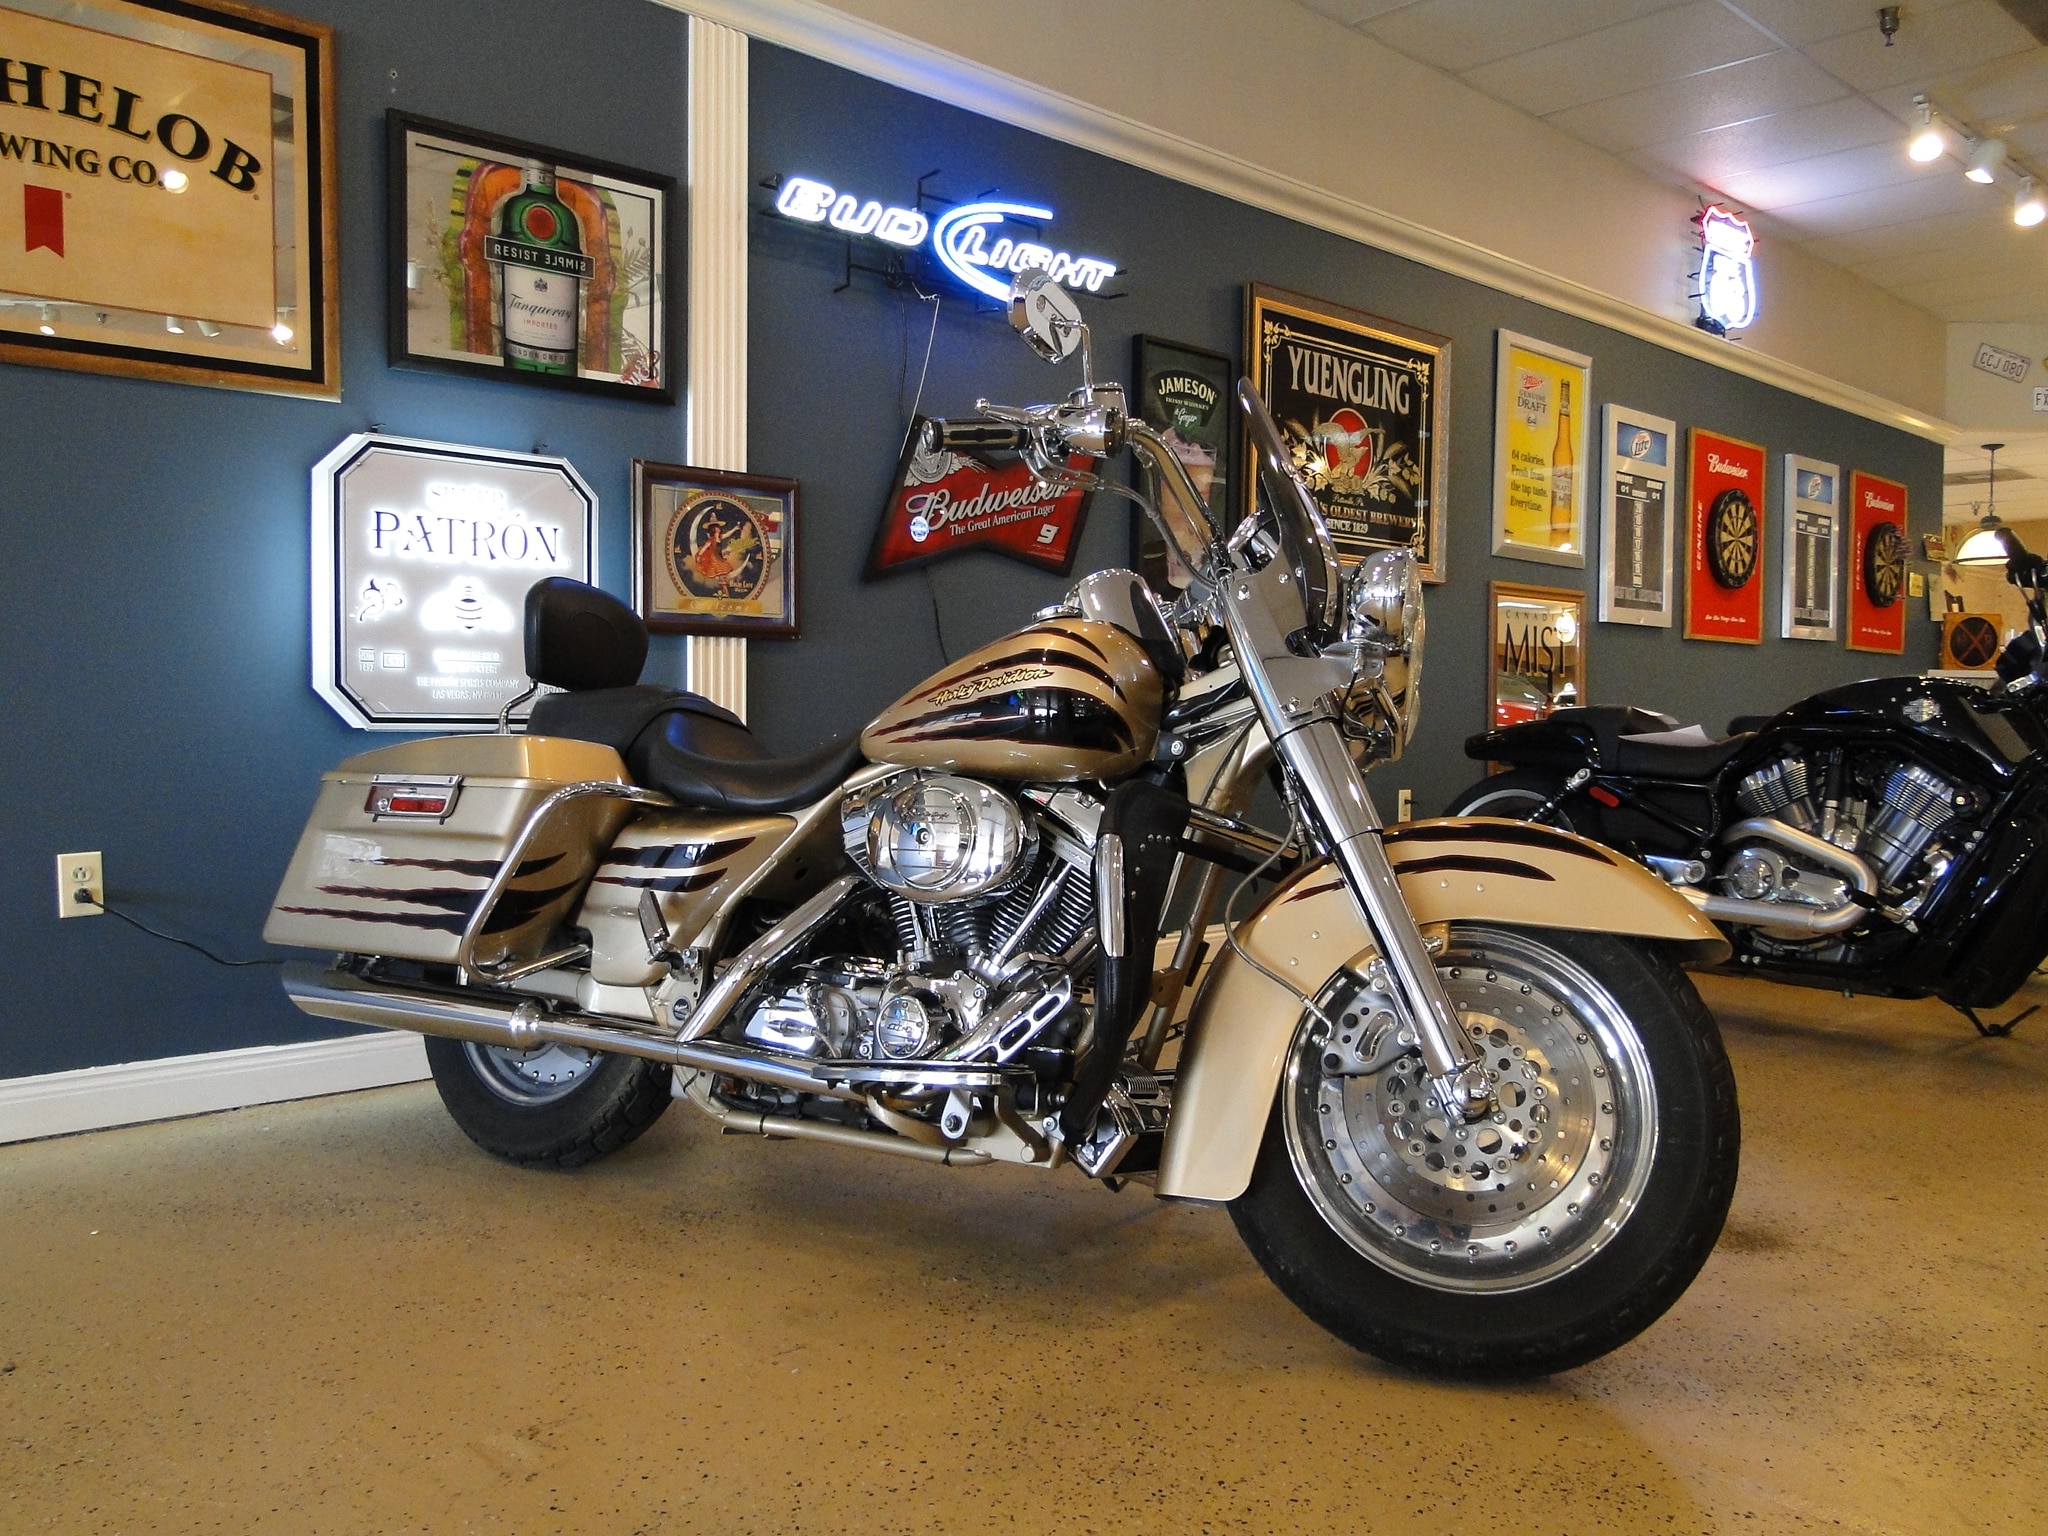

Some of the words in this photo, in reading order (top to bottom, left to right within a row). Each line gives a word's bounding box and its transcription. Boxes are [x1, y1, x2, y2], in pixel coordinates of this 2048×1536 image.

[777, 177, 929, 246] BUD
[494, 244, 538, 262] RESIST
[957, 224, 1117, 292] LIGHT
[509, 293, 573, 320] Tanqueray
[523, 318, 558, 330] IMPORTED
[1158, 376, 1216, 405] JAMESON
[1287, 345, 1411, 415] YUENGLING
[1517, 395, 1547, 414] DRAFT
[1633, 440, 1650, 456] Lite
[1707, 453, 1749, 479] Budweiser
[905, 482, 1070, 532] Budweiser
[950, 523, 967, 536] The
[967, 517, 991, 532] Great
[992, 510, 1032, 527] American
[1033, 504, 1056, 518] Lager
[1329, 504, 1369, 522] OLDEST
[1370, 510, 1418, 529] BREWERY
[1037, 523, 1060, 544] 9
[1325, 517, 1351, 531] SINCE
[1503, 623, 1572, 674] MIST
